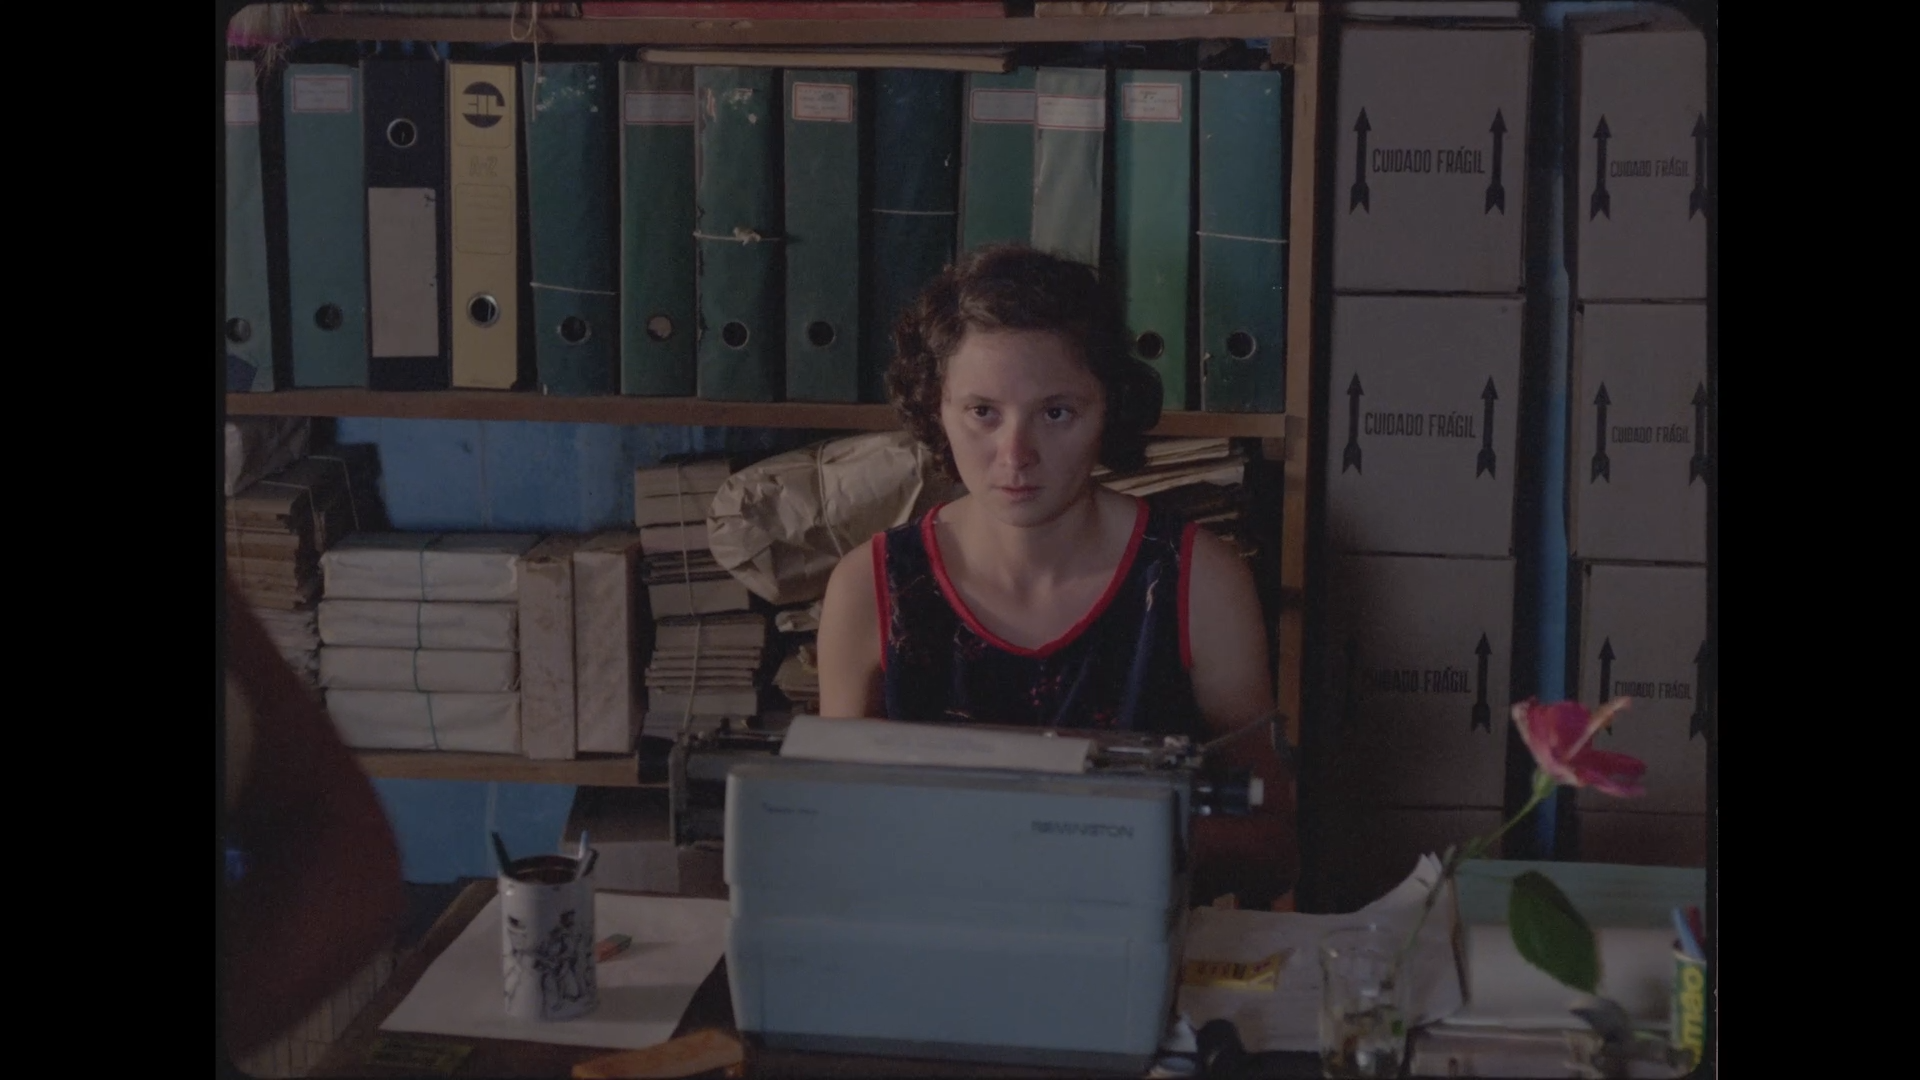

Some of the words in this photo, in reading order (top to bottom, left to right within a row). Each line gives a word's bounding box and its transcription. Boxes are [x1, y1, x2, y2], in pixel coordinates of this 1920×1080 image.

[1372, 148, 1432, 174] CUIDADO
[1437, 146, 1485, 174] FRÁGIL
[1610, 159, 1652, 178] CUIDADO
[1655, 156, 1690, 178] FRÁGIL
[1364, 411, 1423, 437] CUIDADO
[1428, 410, 1476, 438] FRÁGIL
[1611, 426, 1653, 444] CUIDADO
[1655, 423, 1691, 444] FRÁGIL
[1423, 666, 1472, 694] FRÁGIL
[1614, 680, 1655, 699] CUIDADO
[1658, 679, 1693, 700] FRÁGIL
